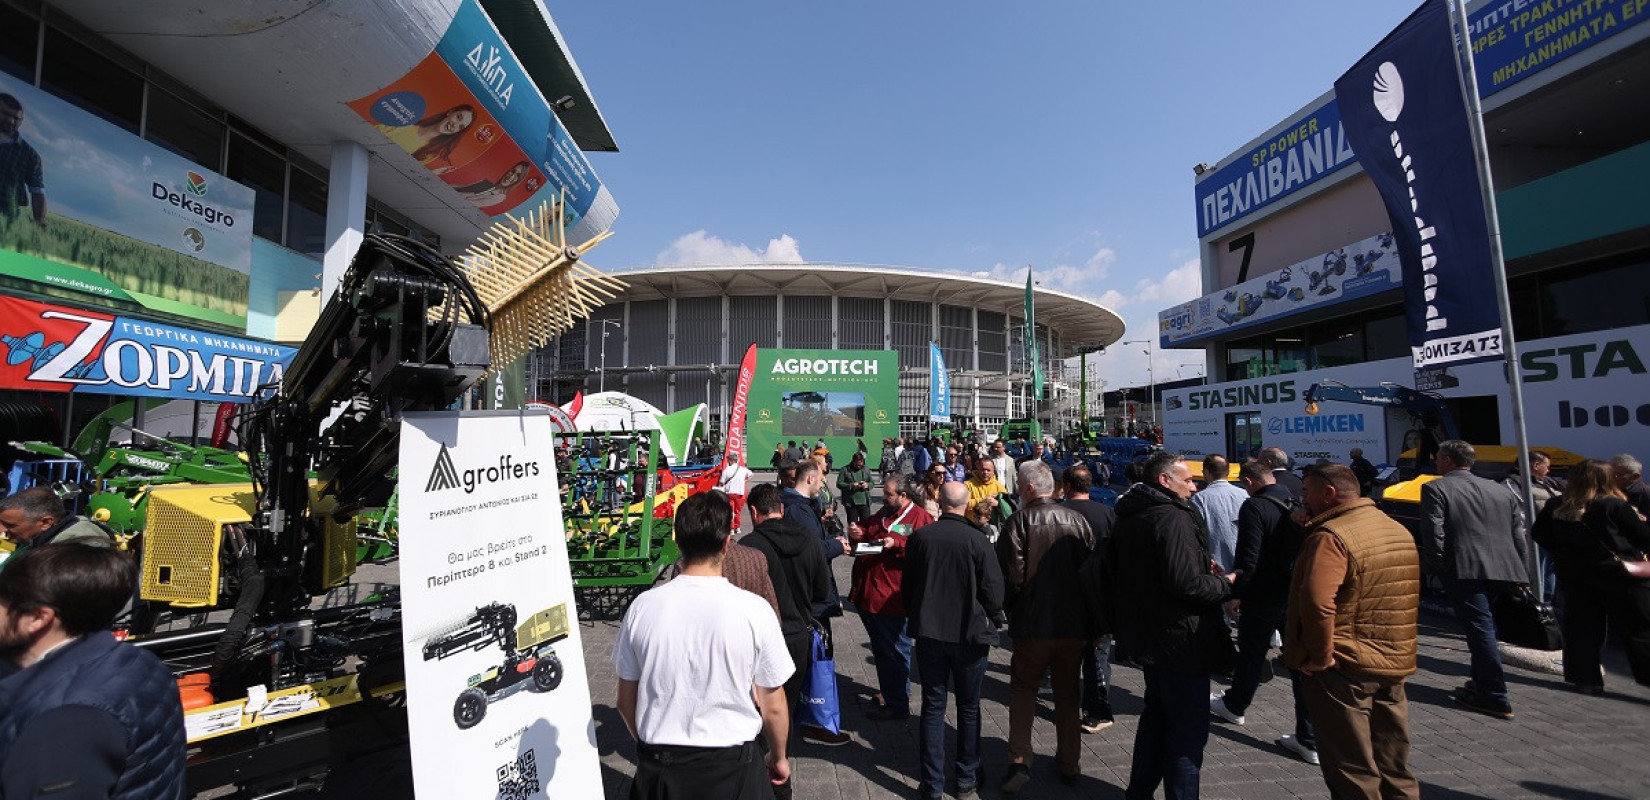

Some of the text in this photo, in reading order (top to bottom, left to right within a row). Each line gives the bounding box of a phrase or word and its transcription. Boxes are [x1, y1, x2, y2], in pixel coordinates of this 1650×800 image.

[1470, 0, 1563, 54] ΗΡΕΣ ΤΡΑΚ
[1493, 11, 1617, 86] ΜΗΧΑΝΗΜΑΤΑ
[1252, 117, 1318, 167] SP POWER
[152, 182, 234, 228] Dekagro
[1228, 231, 1255, 285] 7
[45, 273, 113, 295] www.dekagro.gr
[122, 321, 281, 357] ΓΕΩΡΓΙΚΑ ΜΗΧΑΝΗΜΑΤΑ
[771, 358, 878, 375] AGROTECH
[1521, 339, 1648, 383] STA
[1189, 380, 1296, 410] STASINOS
[1285, 414, 1365, 437] LEMKEN
[1294, 451, 1331, 459] STASINOS
[426, 545, 548, 588] Περίπτερο 8 και Stand 2
[447, 535, 533, 564] Θα μας βρείτε στο
[495, 736, 513, 749] SCAN
